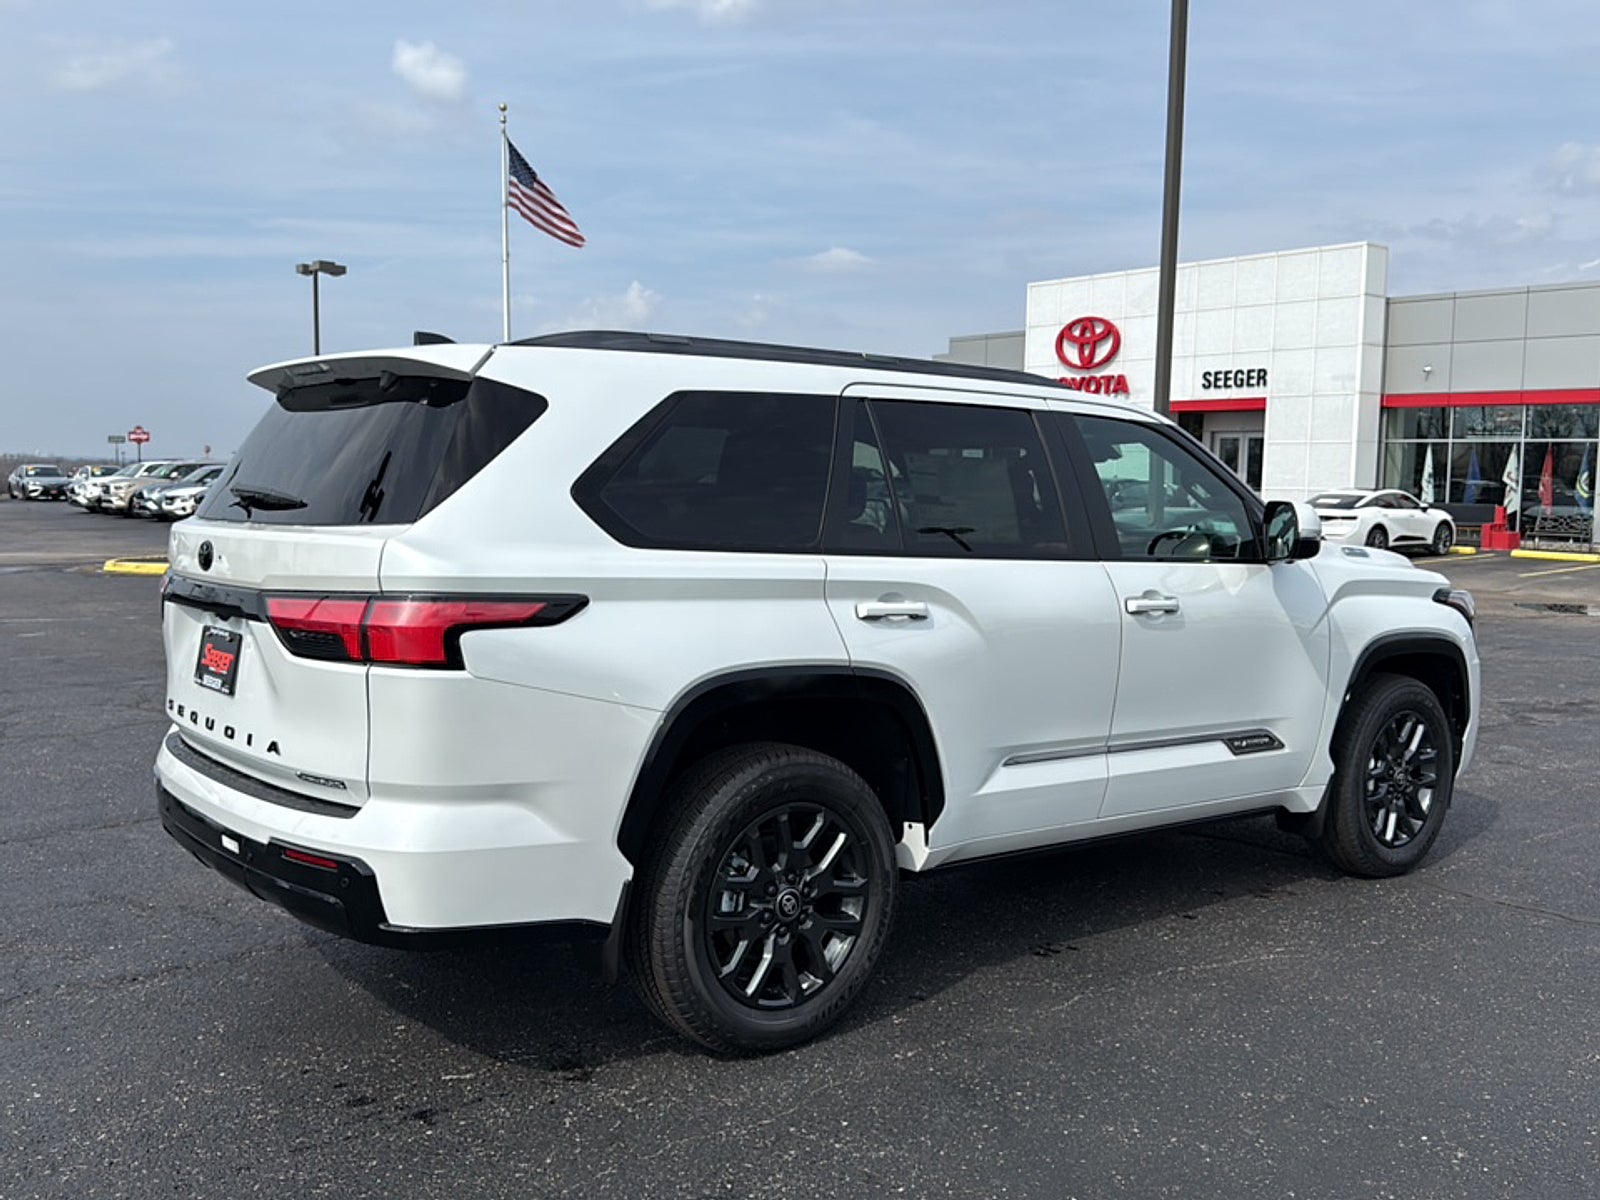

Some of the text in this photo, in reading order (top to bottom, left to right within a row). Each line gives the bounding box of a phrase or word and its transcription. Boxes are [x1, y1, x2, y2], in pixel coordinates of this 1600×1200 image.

[1057, 374, 1130, 394] YOTA
[1201, 368, 1268, 390] SEEGER
[168, 699, 281, 756] SEQUOIA
